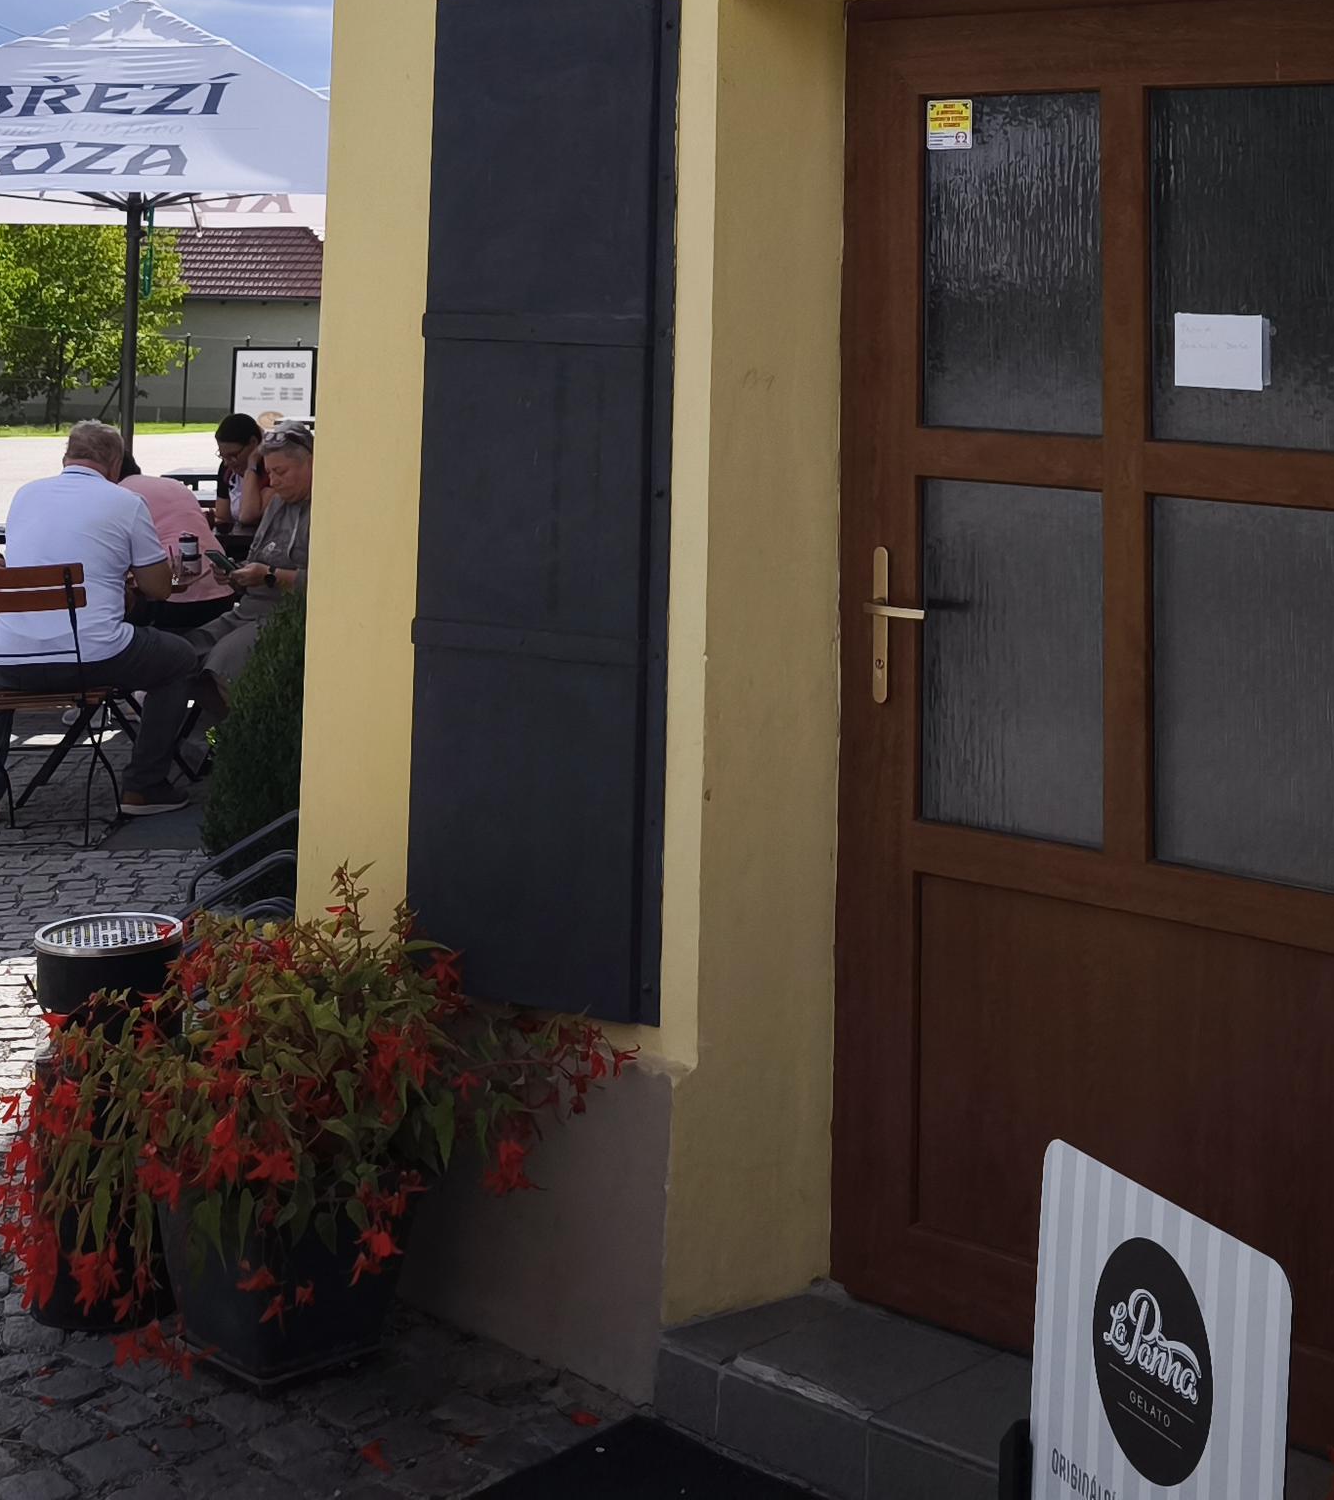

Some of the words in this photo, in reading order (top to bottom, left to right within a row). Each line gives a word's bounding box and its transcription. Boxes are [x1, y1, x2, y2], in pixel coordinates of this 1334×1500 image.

[1103, 1301, 1130, 1356] La
[1124, 1288, 1202, 1405] Panna
[1129, 1390, 1171, 1428] GELATO
